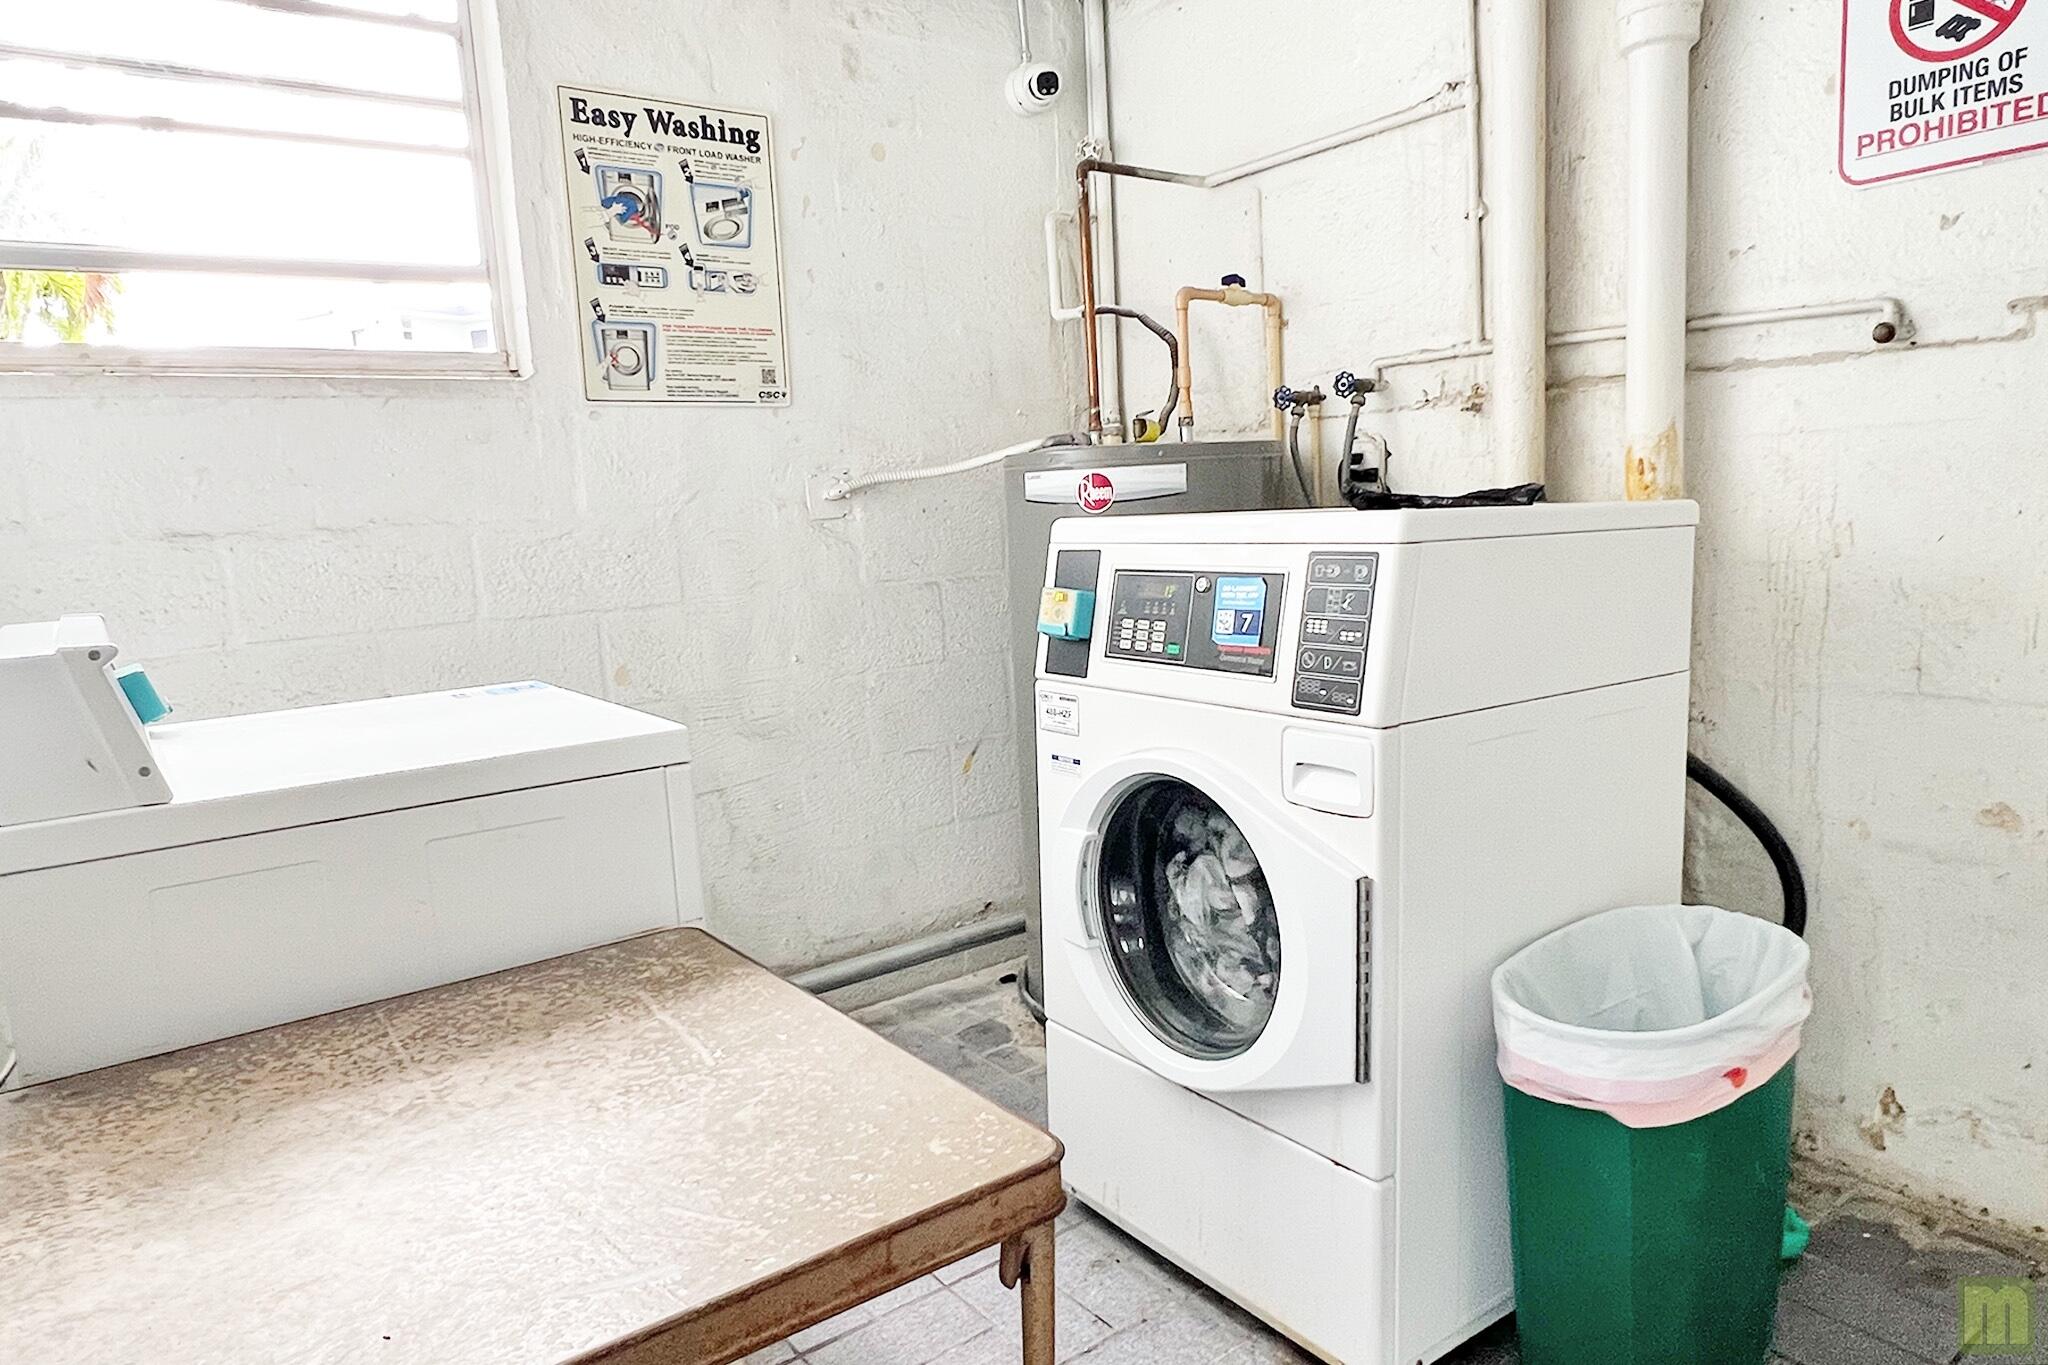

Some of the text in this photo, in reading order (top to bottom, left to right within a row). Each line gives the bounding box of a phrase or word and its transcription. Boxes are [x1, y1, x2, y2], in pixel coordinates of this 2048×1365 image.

[1889, 46, 2028, 100] DUMPING OF
[1890, 73, 2024, 123] BULK ITEMS
[569, 97, 761, 154] Easy Washing
[573, 133, 652, 150] HIGH-EFFICIENCY
[667, 145, 697, 157] FRONT
[699, 150, 723, 159] LOAD
[725, 153, 762, 164] WASHER
[758, 391, 780, 399] CSC
[1080, 474, 1113, 506] Rheem
[1241, 612, 1255, 634] 7
